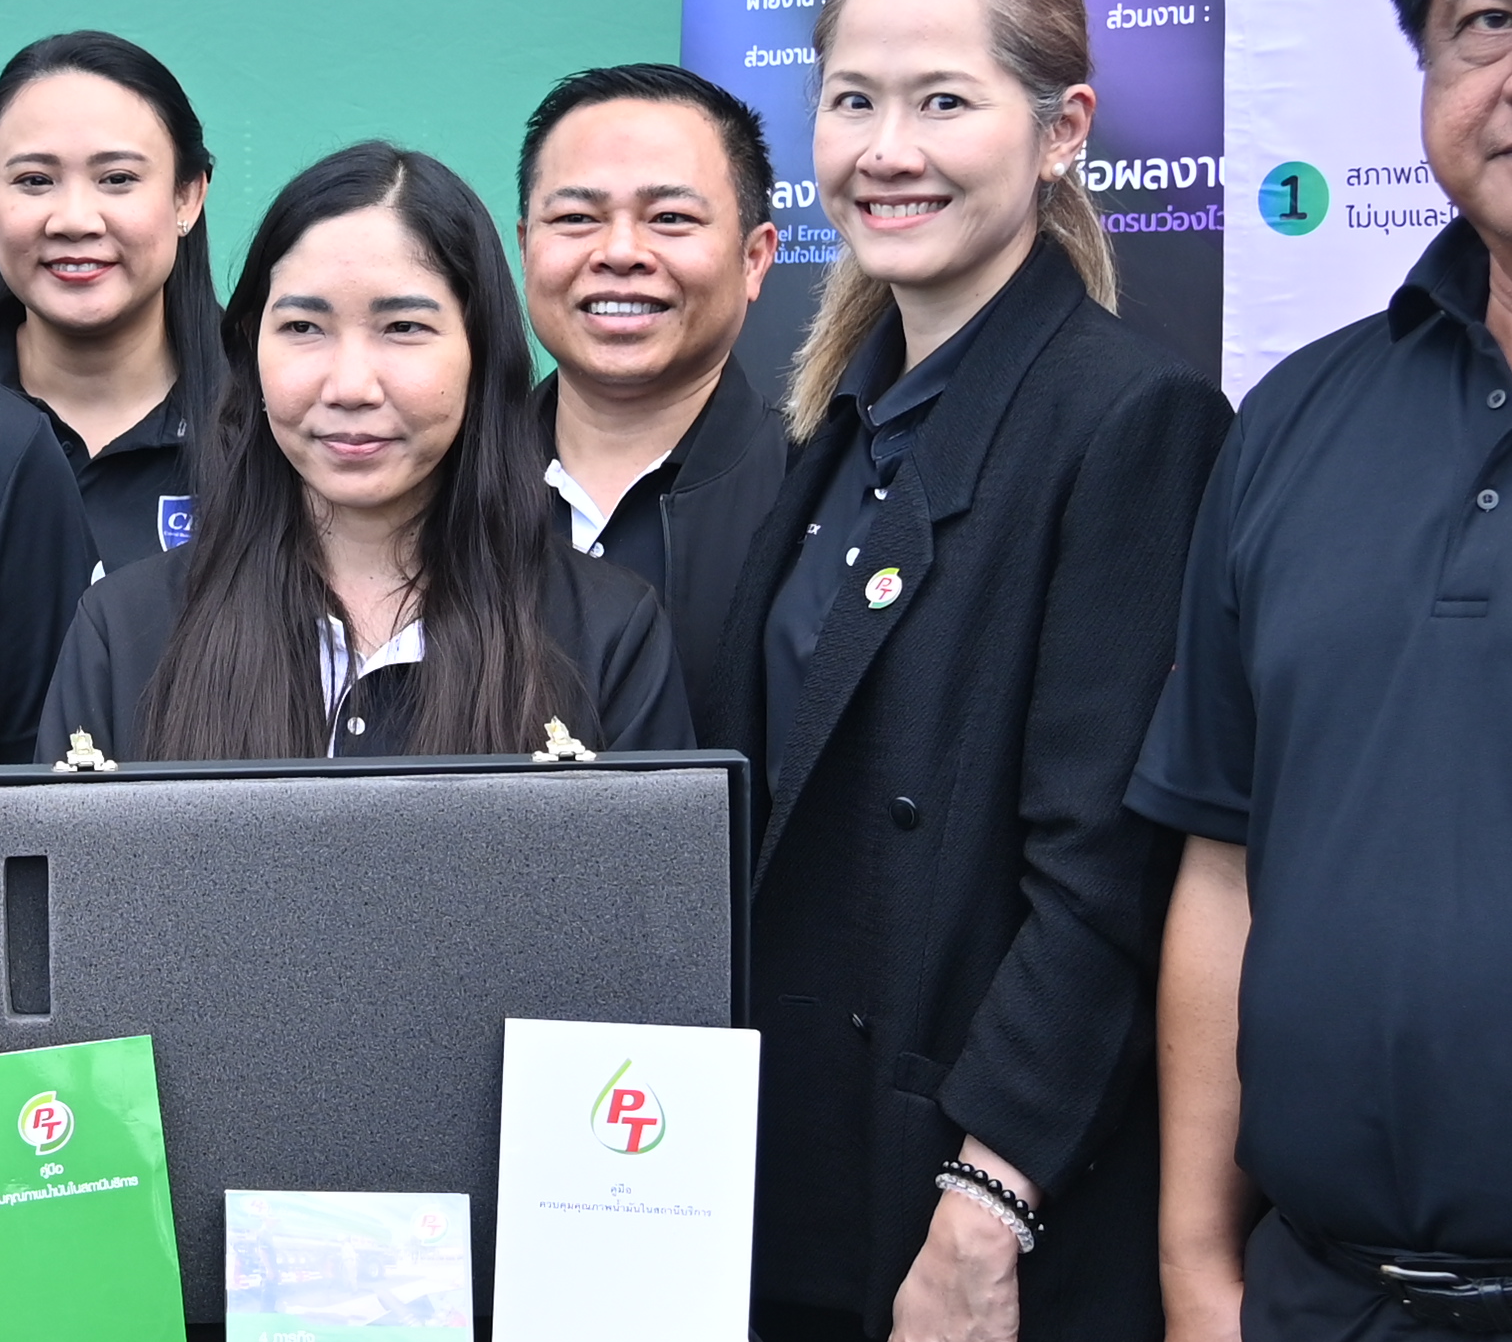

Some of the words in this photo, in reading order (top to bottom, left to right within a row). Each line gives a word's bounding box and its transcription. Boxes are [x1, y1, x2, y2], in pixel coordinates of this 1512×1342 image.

[1106, 3, 1195, 29] ส่วนงาน
[744, 45, 815, 67] ส่วนงาน
[1279, 175, 1307, 220] 1
[32, 1107, 61, 1140] PT
[607, 1089, 657, 1153] PT
